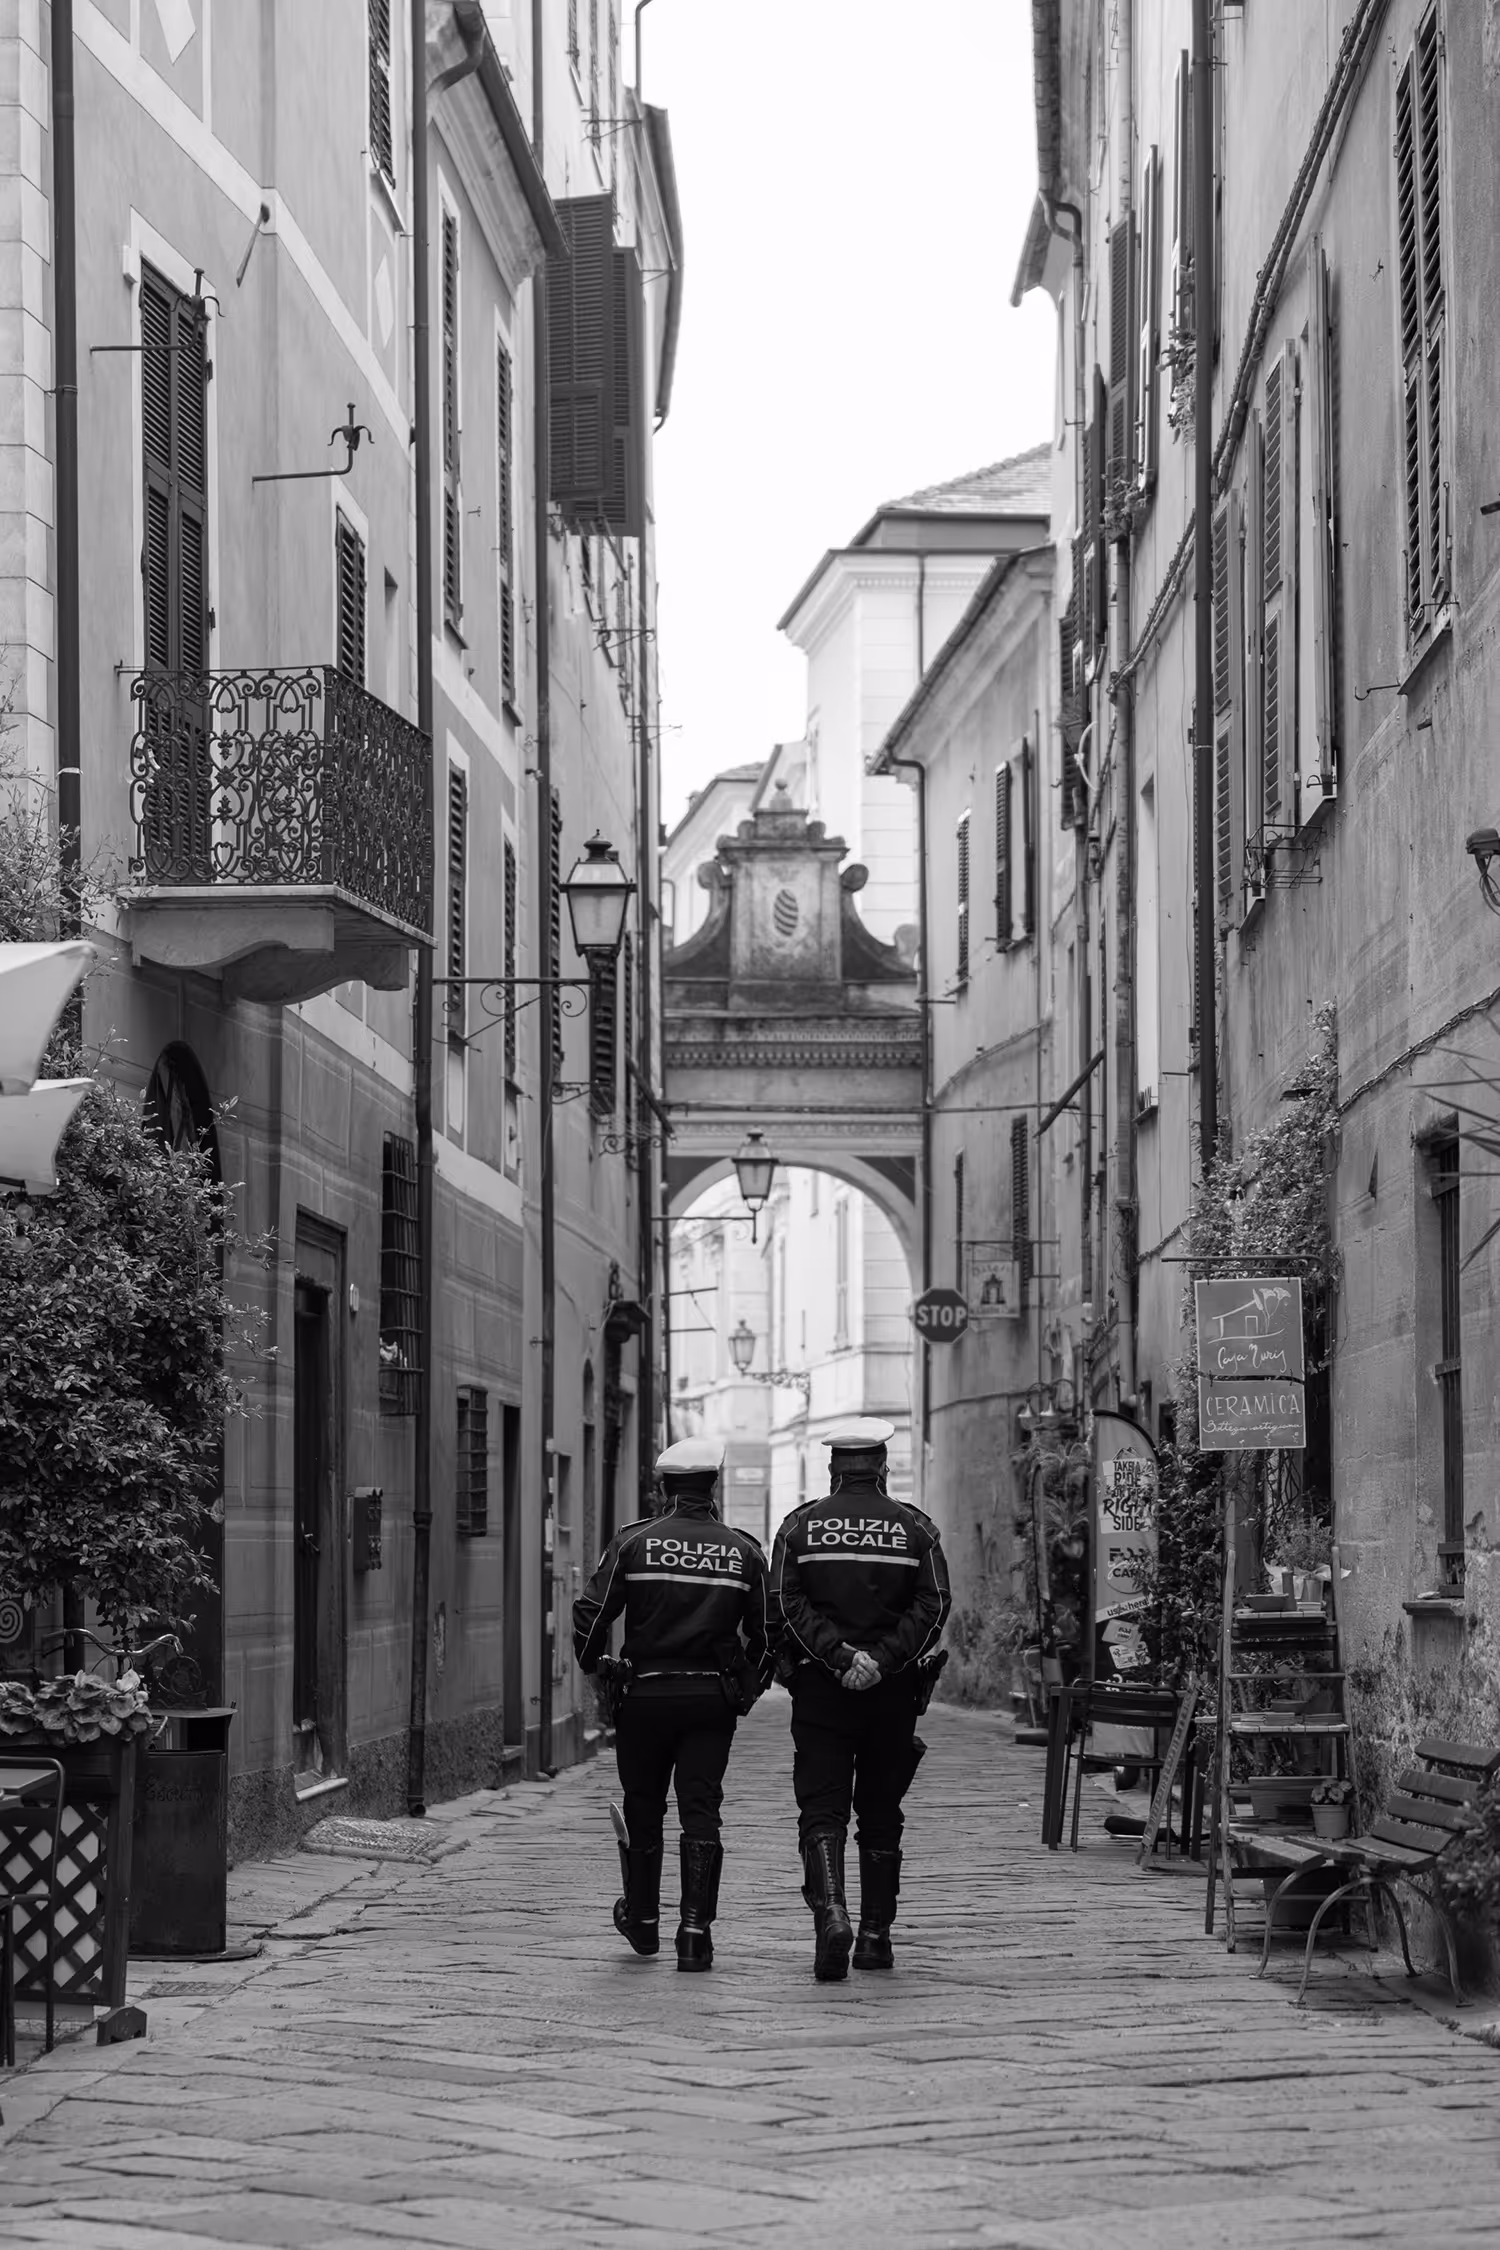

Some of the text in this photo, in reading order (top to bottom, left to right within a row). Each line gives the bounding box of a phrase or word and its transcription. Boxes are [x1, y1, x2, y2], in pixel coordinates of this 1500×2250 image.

[917, 1304, 967, 1327] STOP
[1206, 1392, 1302, 1418] CERAMICA
[1202, 1420, 1247, 1436] Bottega
[807, 1517, 908, 1536] POLIZIA
[1113, 1515, 1140, 1532] SIDE
[646, 1538, 743, 1561] POLIZIA
[807, 1531, 908, 1550] LOCALE
[646, 1552, 743, 1575] LOCALE
